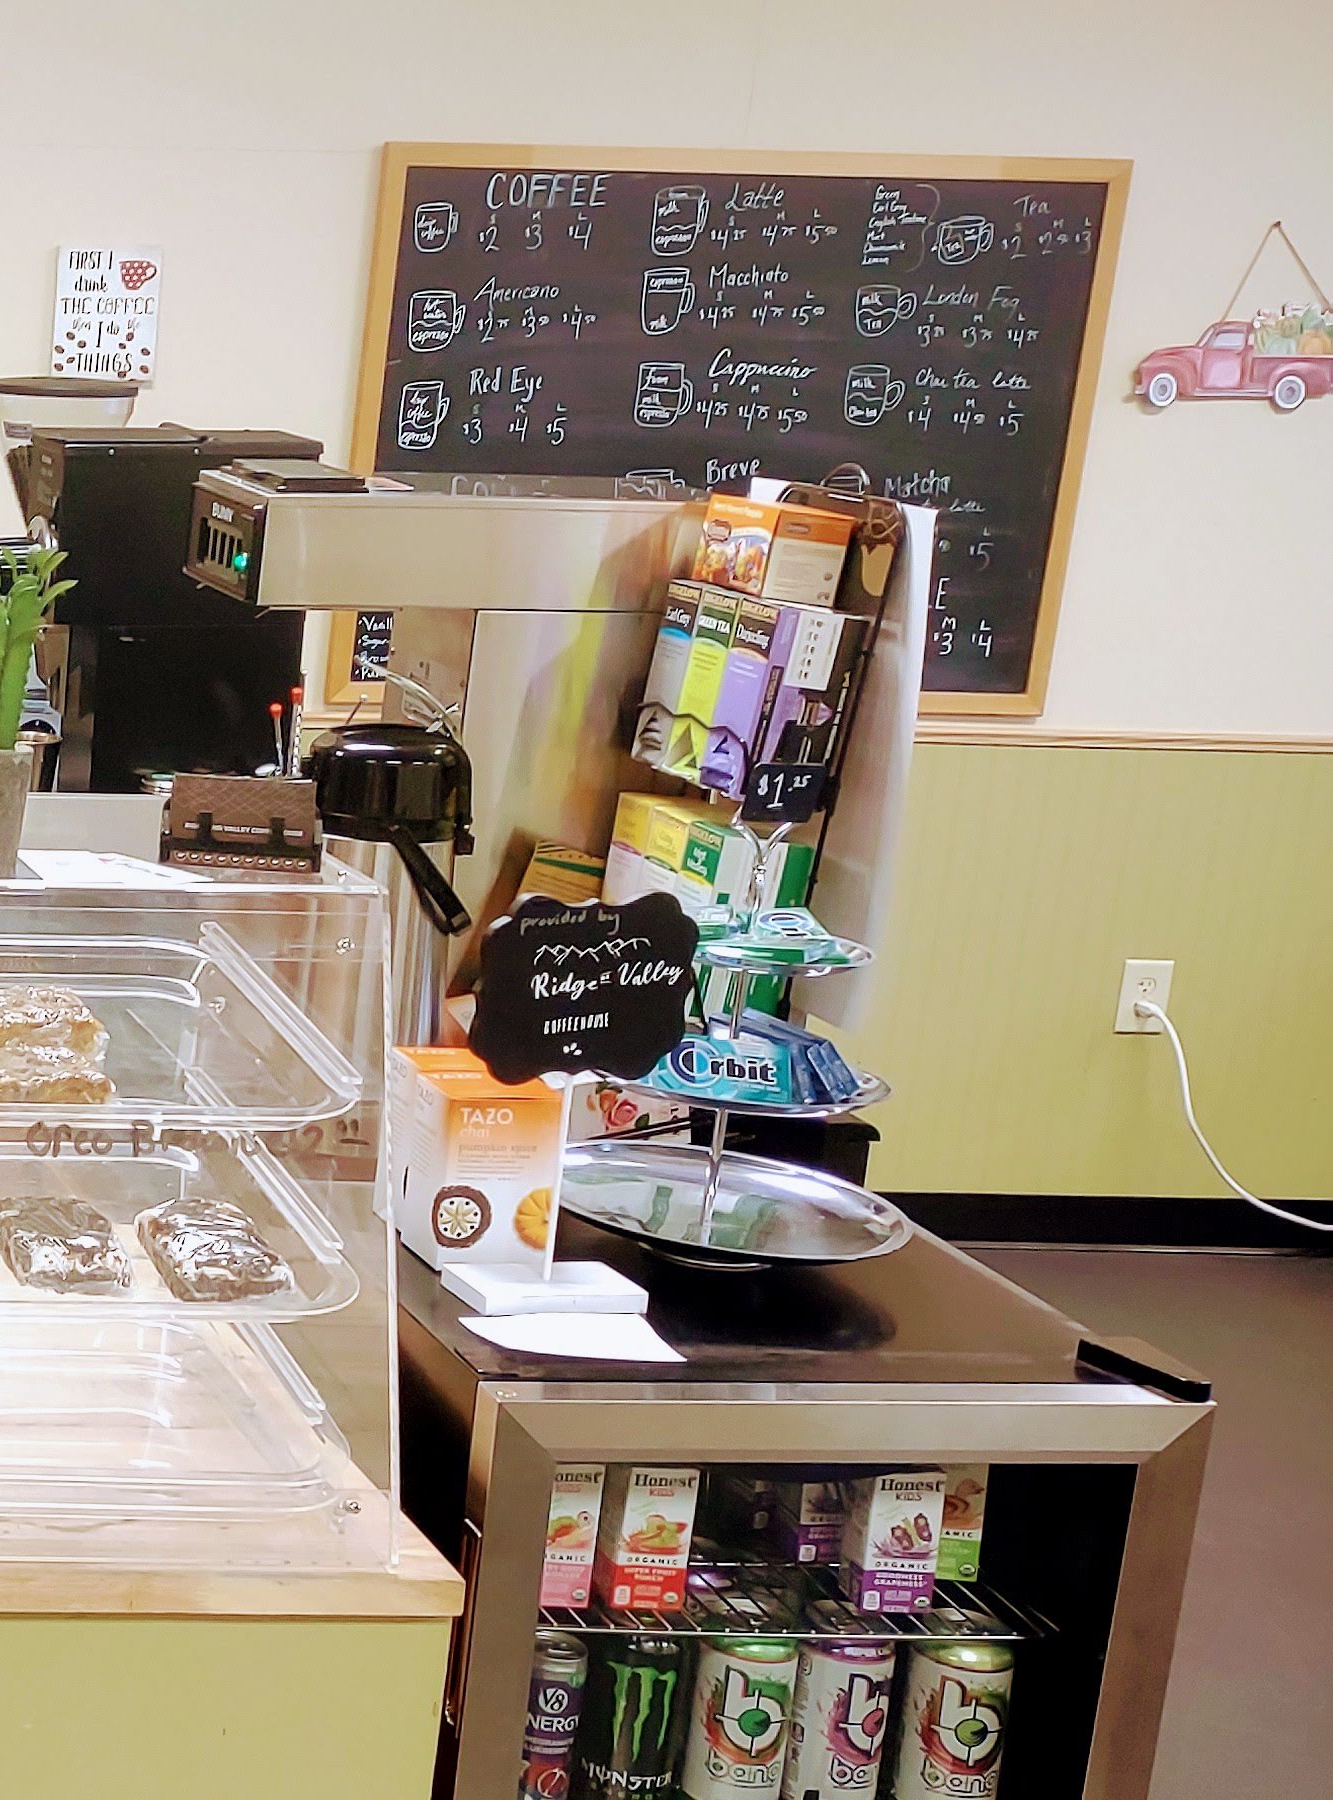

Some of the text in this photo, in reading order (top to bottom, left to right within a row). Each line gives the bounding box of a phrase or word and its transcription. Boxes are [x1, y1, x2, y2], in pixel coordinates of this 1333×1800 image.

[487, 173, 612, 209] COFFEE
[725, 182, 784, 212] Latte
[813, 207, 822, 219] L
[1013, 194, 1051, 217] Tea
[68, 249, 104, 271] FIRST
[74, 273, 109, 293] drink
[709, 262, 789, 290] Macchiato
[473, 276, 561, 311] Americano
[805, 289, 816, 300] L
[921, 282, 980, 308] London
[60, 296, 156, 316] THE COFFEE
[75, 352, 133, 374] THINGS
[708, 347, 819, 386] Cappuccino
[469, 366, 544, 403] Red Eye
[953, 367, 982, 390] tea
[706, 456, 761, 486] Breve
[884, 468, 952, 499] Matcha
[940, 614, 993, 632] M L
[519, 908, 621, 937] provided by
[530, 971, 599, 1001] Ridge
[618, 959, 685, 986] Valley
[667, 1037, 777, 1089] Orbit
[459, 1106, 515, 1127] TAZO
[26, 1120, 114, 1159] Oreo
[458, 1124, 491, 1139] chai
[555, 1472, 604, 1484] onest
[634, 1473, 698, 1489] Honest
[880, 1478, 946, 1493] Honest
[943, 1529, 974, 1538] ANIC
[545, 1553, 587, 1562] GANIC
[626, 1555, 679, 1567] ORGANIC
[874, 1560, 929, 1571] ORGANIC
[541, 1688, 567, 1713] V8
